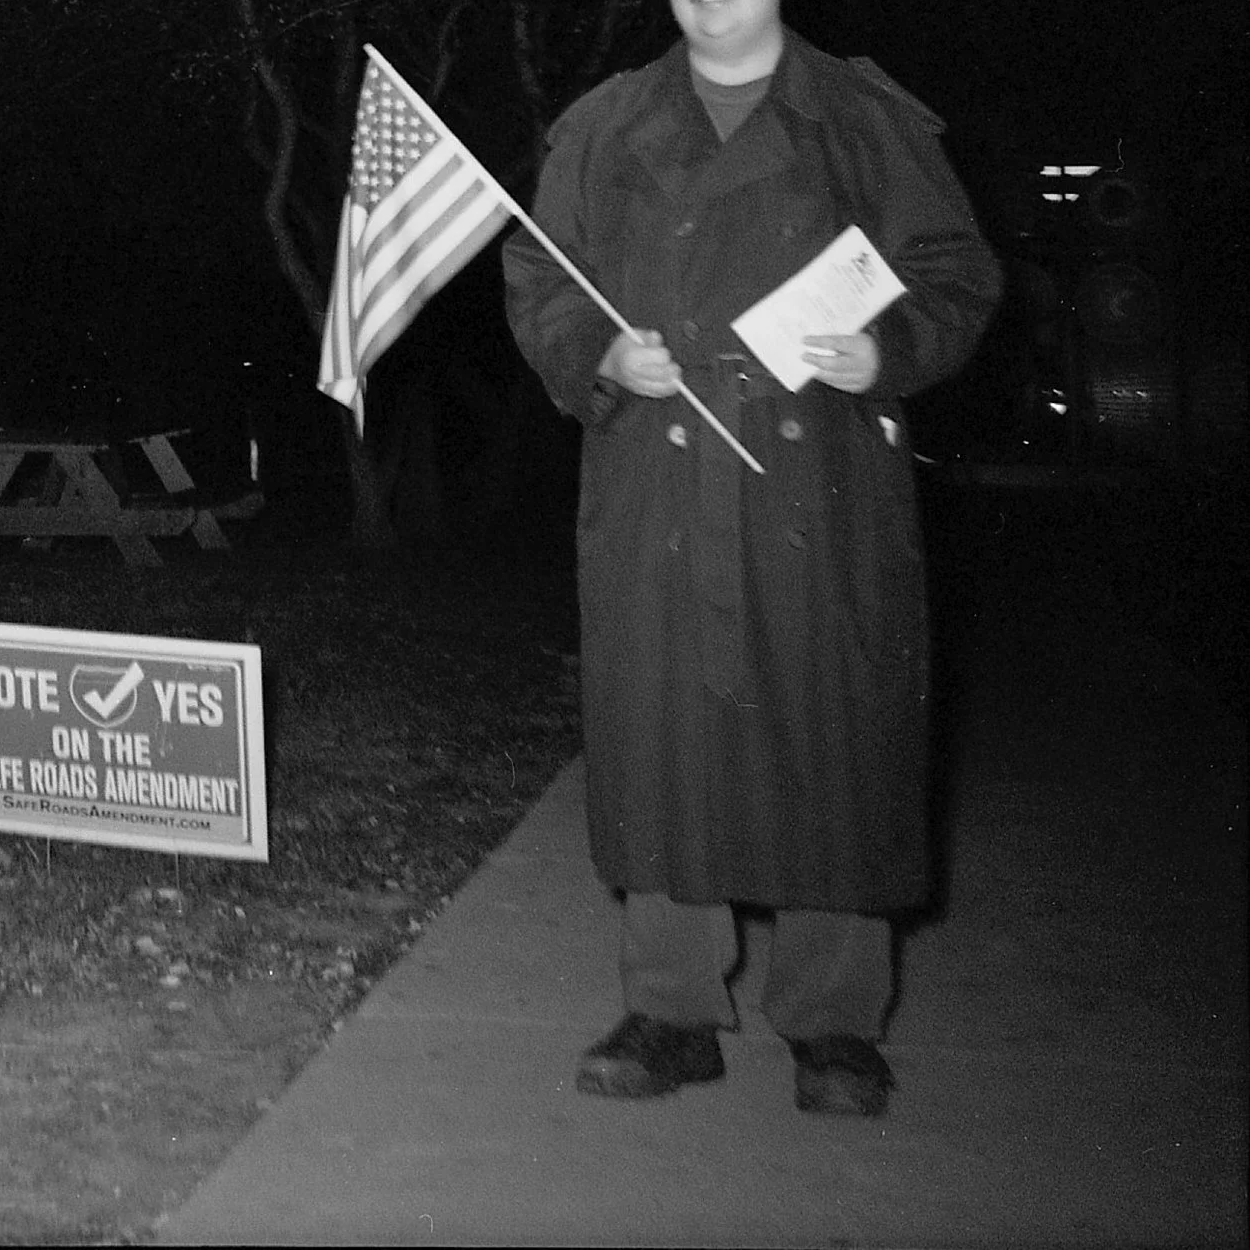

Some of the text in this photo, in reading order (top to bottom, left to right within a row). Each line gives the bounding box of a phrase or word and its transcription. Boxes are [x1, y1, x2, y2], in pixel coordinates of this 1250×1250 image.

[153, 680, 224, 728] YES
[52, 726, 151, 767] ON THE
[29, 759, 98, 799] ROADS
[105, 768, 239, 815] AMENDMENT
